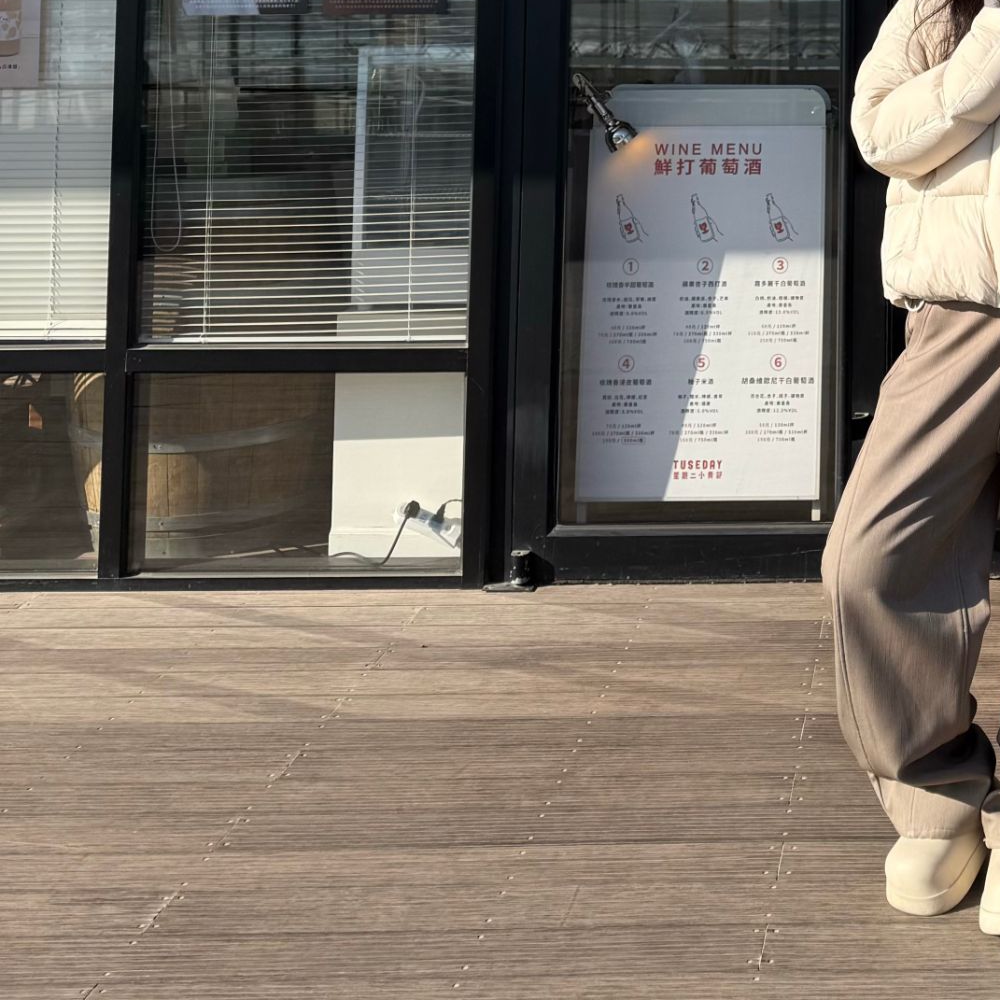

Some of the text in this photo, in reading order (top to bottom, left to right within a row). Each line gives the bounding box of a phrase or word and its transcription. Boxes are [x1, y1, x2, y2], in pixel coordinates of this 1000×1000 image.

[654, 143, 762, 155] WINE MENU
[654, 159, 762, 176] 鮮打葡萄酒
[673, 460, 722, 470] TUSEDAY
